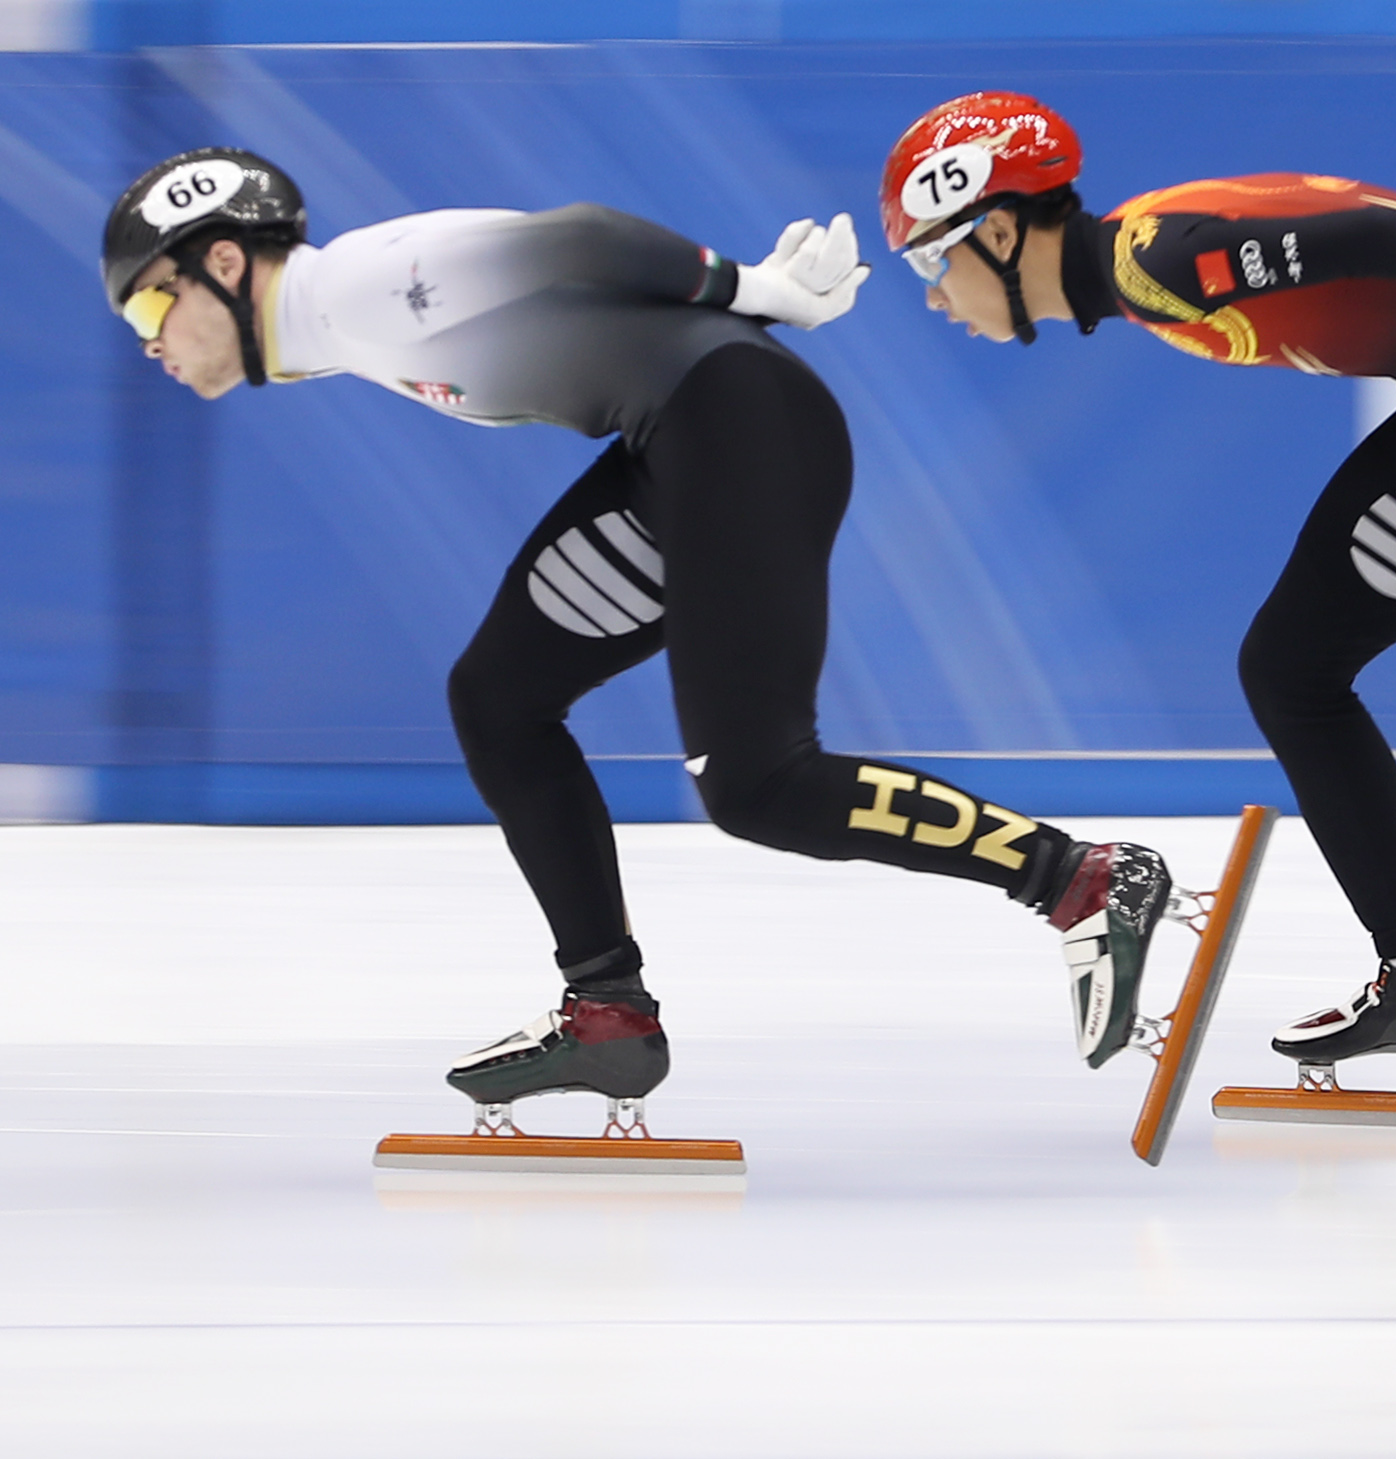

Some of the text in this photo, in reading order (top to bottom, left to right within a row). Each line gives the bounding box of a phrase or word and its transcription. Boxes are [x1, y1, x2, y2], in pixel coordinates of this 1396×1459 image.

[166, 169, 218, 209] 66
[917, 157, 969, 205] 75
[848, 765, 1038, 870] HUN
